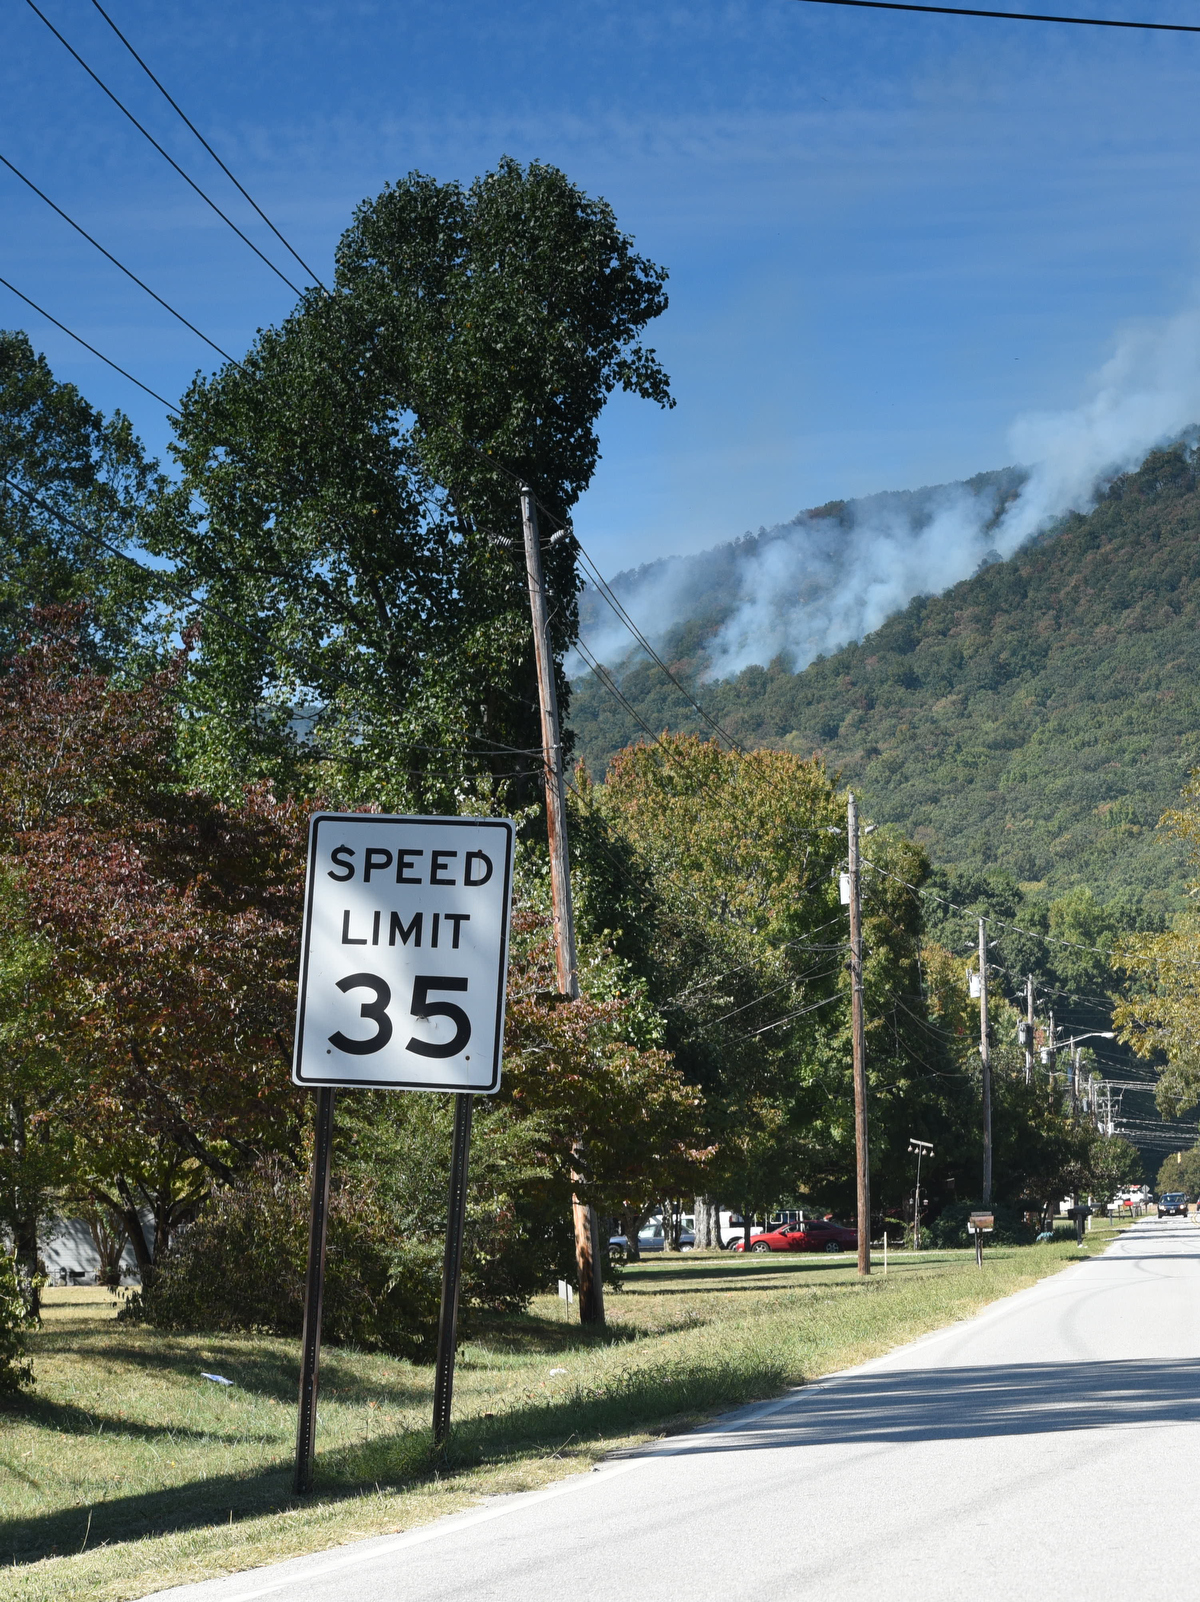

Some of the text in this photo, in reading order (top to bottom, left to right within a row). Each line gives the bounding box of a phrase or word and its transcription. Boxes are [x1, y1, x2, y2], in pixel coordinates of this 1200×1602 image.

[327, 846, 493, 887] SPEED
[341, 909, 471, 949] LIMIT
[327, 972, 472, 1059] 35
